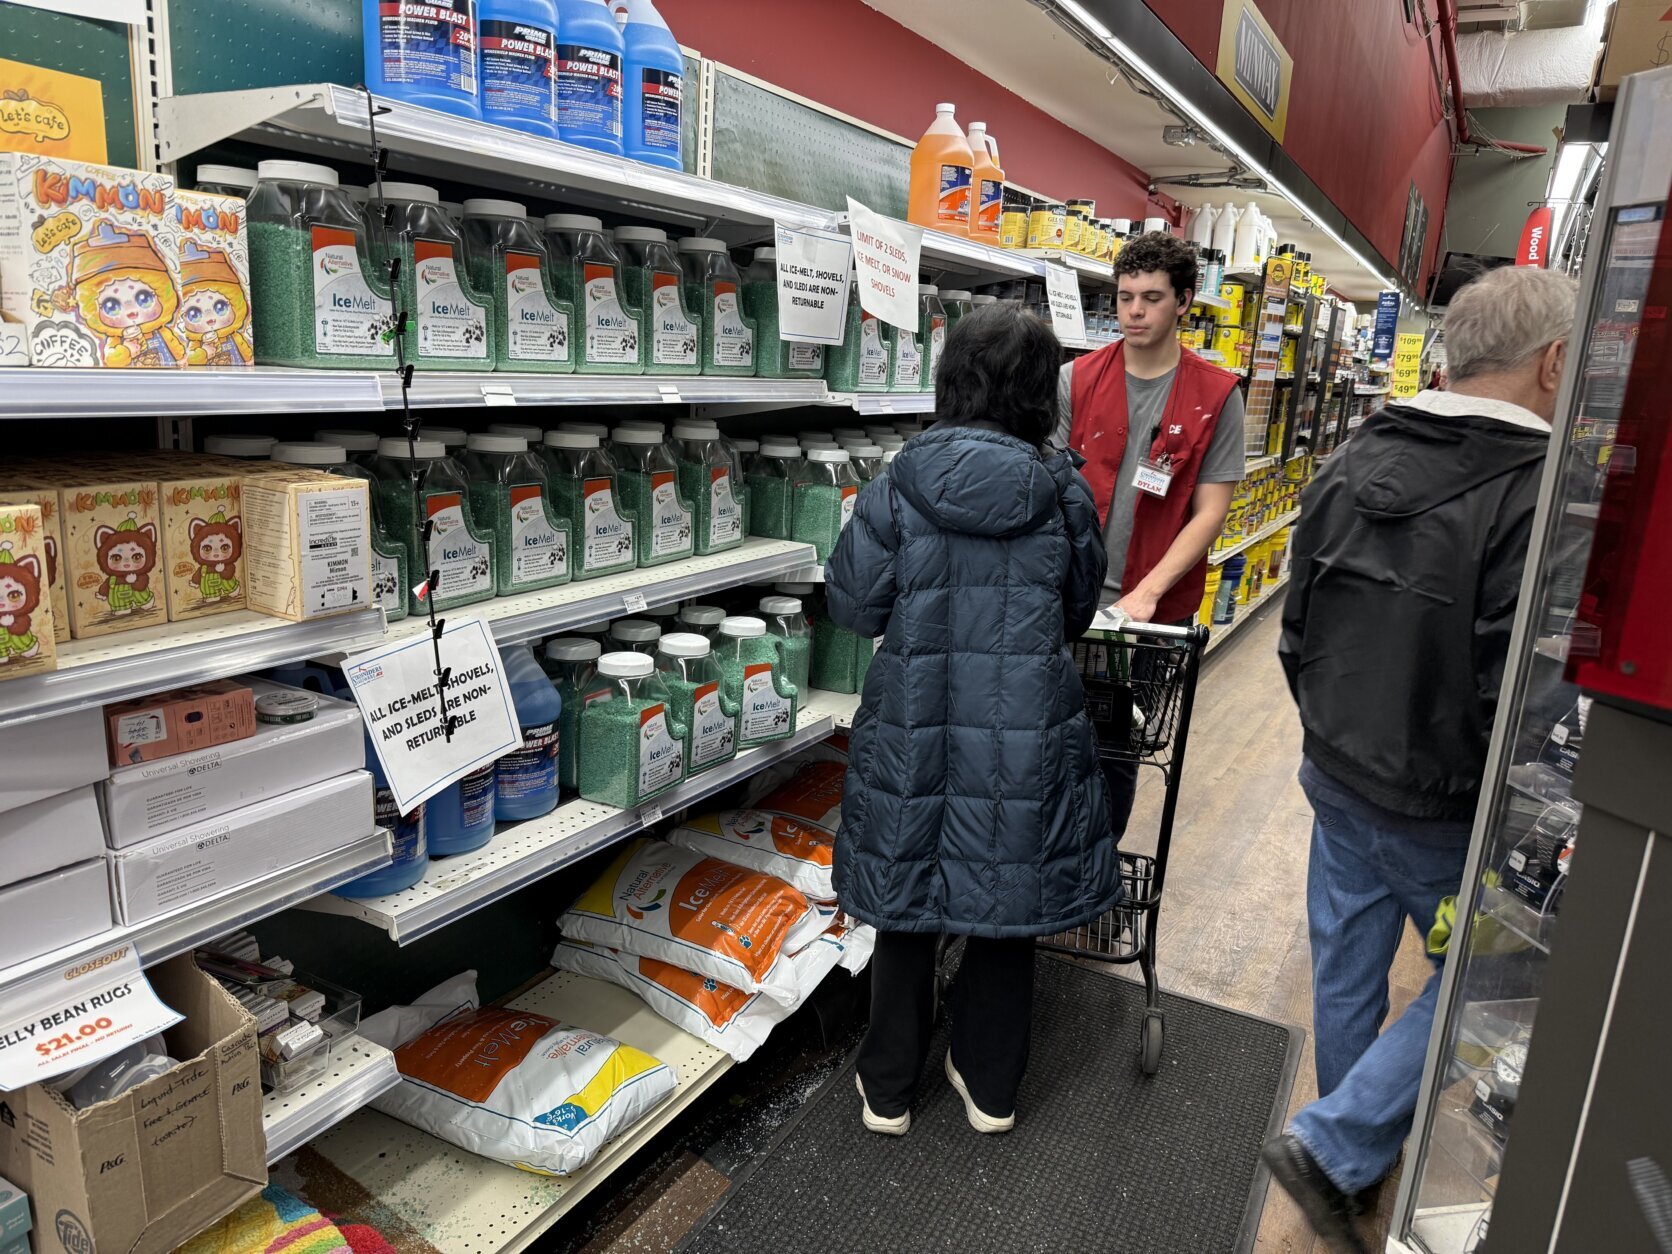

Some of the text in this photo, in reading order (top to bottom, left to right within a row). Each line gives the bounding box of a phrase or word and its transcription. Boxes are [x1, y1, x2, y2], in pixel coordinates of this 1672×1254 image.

[399, 4, 467, 25] POWER BLAST
[513, 26, 548, 40] PRIME
[501, 39, 554, 59] POWER BLAS
[578, 49, 612, 64] PRIME
[566, 62, 619, 79] POWER BLAST
[1237, 19, 1278, 110] MINWAX
[34, 114, 65, 130] cafe
[857, 230, 908, 264] LIMIT OF 2 SLEDS,
[1528, 226, 1543, 260] Wood
[325, 252, 344, 261] Natural
[780, 263, 844, 284] ALL ICE-MELT, SHOVELS,
[865, 255, 881, 273] MELT,
[882, 263, 891, 275] OR
[892, 267, 912, 283] SNOW
[783, 279, 839, 296] AND SLEDS ARE NON-
[871, 278, 895, 298] SHOVELS
[332, 293, 376, 311] IceMelt
[432, 301, 471, 316] IceMelt
[792, 296, 825, 309] RETURNABLE
[520, 308, 555, 323] IceMelt
[597, 314, 628, 327] IceMelt
[662, 320, 689, 332] IceMelt
[722, 324, 745, 336] IceMelt
[33, 334, 89, 356] COFFEE
[1169, 424, 1183, 434] CE
[1137, 480, 1162, 493] DYLAN
[661, 514, 684, 525] IceMelt
[717, 506, 736, 517] IceMelt
[595, 523, 623, 536] IceMelt
[524, 534, 556, 548] IceMelt
[442, 546, 477, 560] IceMelt
[327, 559, 349, 568] KIMMON
[382, 722, 403, 742] AND
[405, 706, 437, 730] SLEDS
[462, 684, 491, 704] NON-
[752, 699, 780, 711] IceMelt
[369, 707, 387, 724] ALL
[526, 724, 554, 736] PRIME
[702, 720, 726, 734] IceMelt
[649, 744, 674, 761] IceMelt
[1559, 746, 1580, 759] CASI
[142, 751, 221, 778] Universal Showering
[196, 761, 220, 773] DELTA
[152, 825, 229, 855] Universal Showering
[205, 834, 228, 847] DELTA
[619, 869, 649, 901] Natural
[633, 862, 672, 901] Alternative
[679, 869, 731, 911] IceMelt
[64, 947, 129, 981] CLOSEOUT
[0, 983, 133, 1051] ELLY BEAN RUGS
[35, 1017, 113, 1057] $21.00
[37, 1059, 50, 1067] ALL
[51, 1051, 70, 1062] SALES
[70, 1044, 89, 1055] FINAL
[106, 1023, 133, 1038] RETURNS
[575, 1036, 608, 1057] atural
[231, 1076, 251, 1097] P&G
[100, 1152, 127, 1175] P&G
[61, 1219, 89, 1250] Tide
